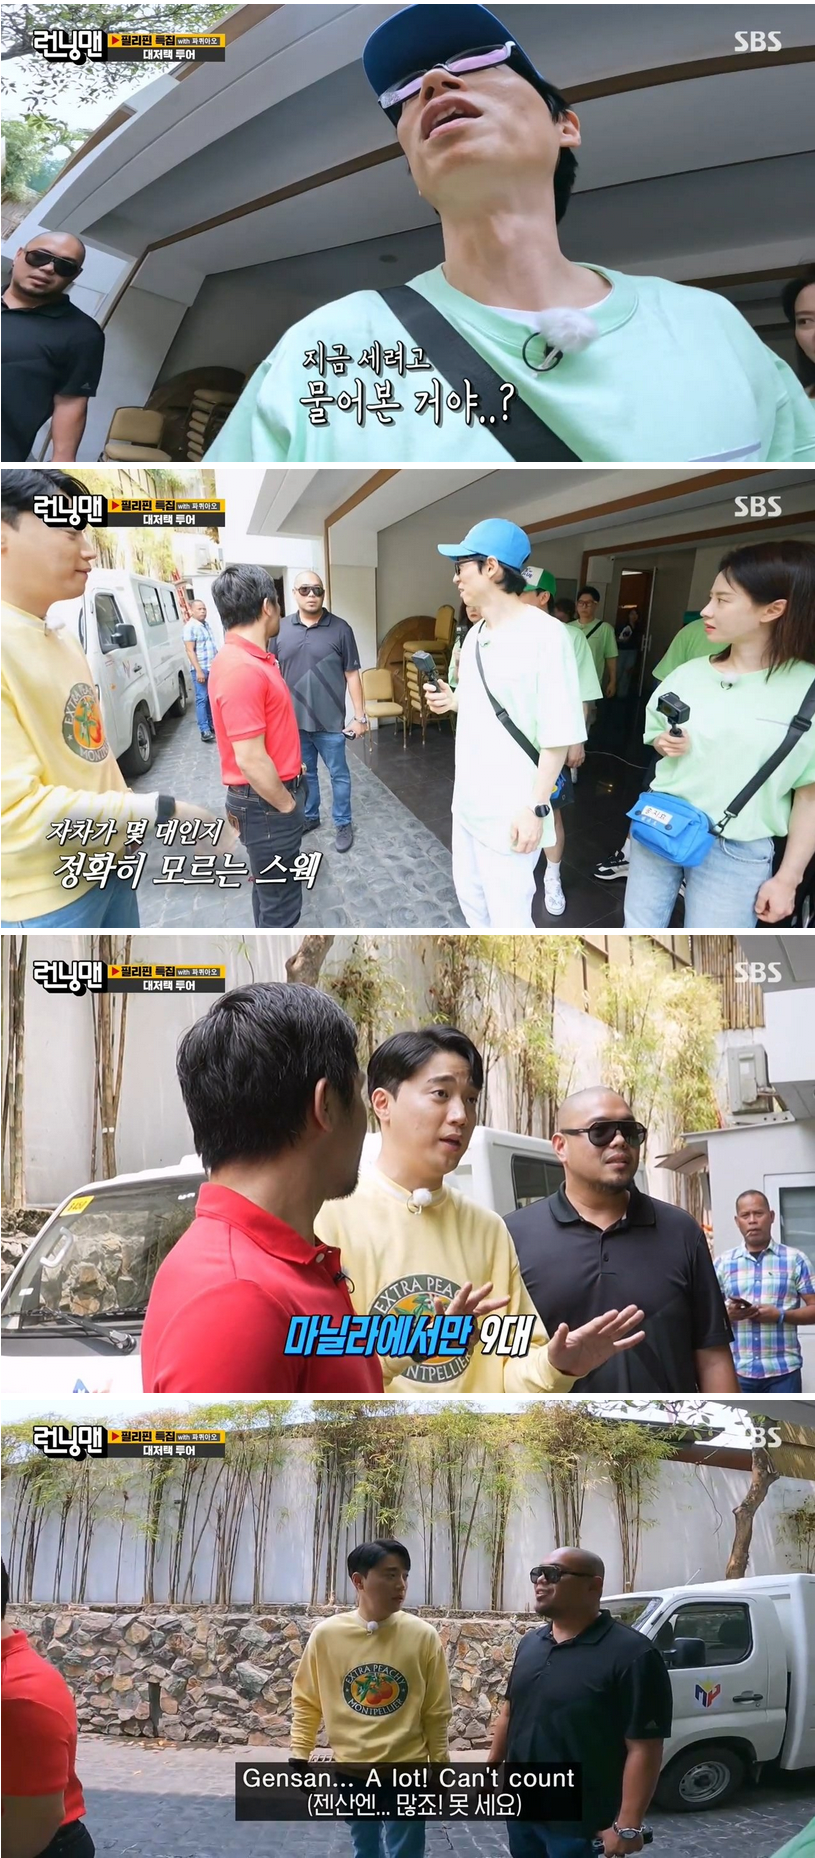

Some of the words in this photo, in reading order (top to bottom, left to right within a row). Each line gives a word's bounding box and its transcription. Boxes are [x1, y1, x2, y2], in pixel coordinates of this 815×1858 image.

[374, 1276, 424, 1312] EXTRA
[345, 1665, 371, 1684] EXTRA
[373, 1664, 406, 1685] PEACHY
